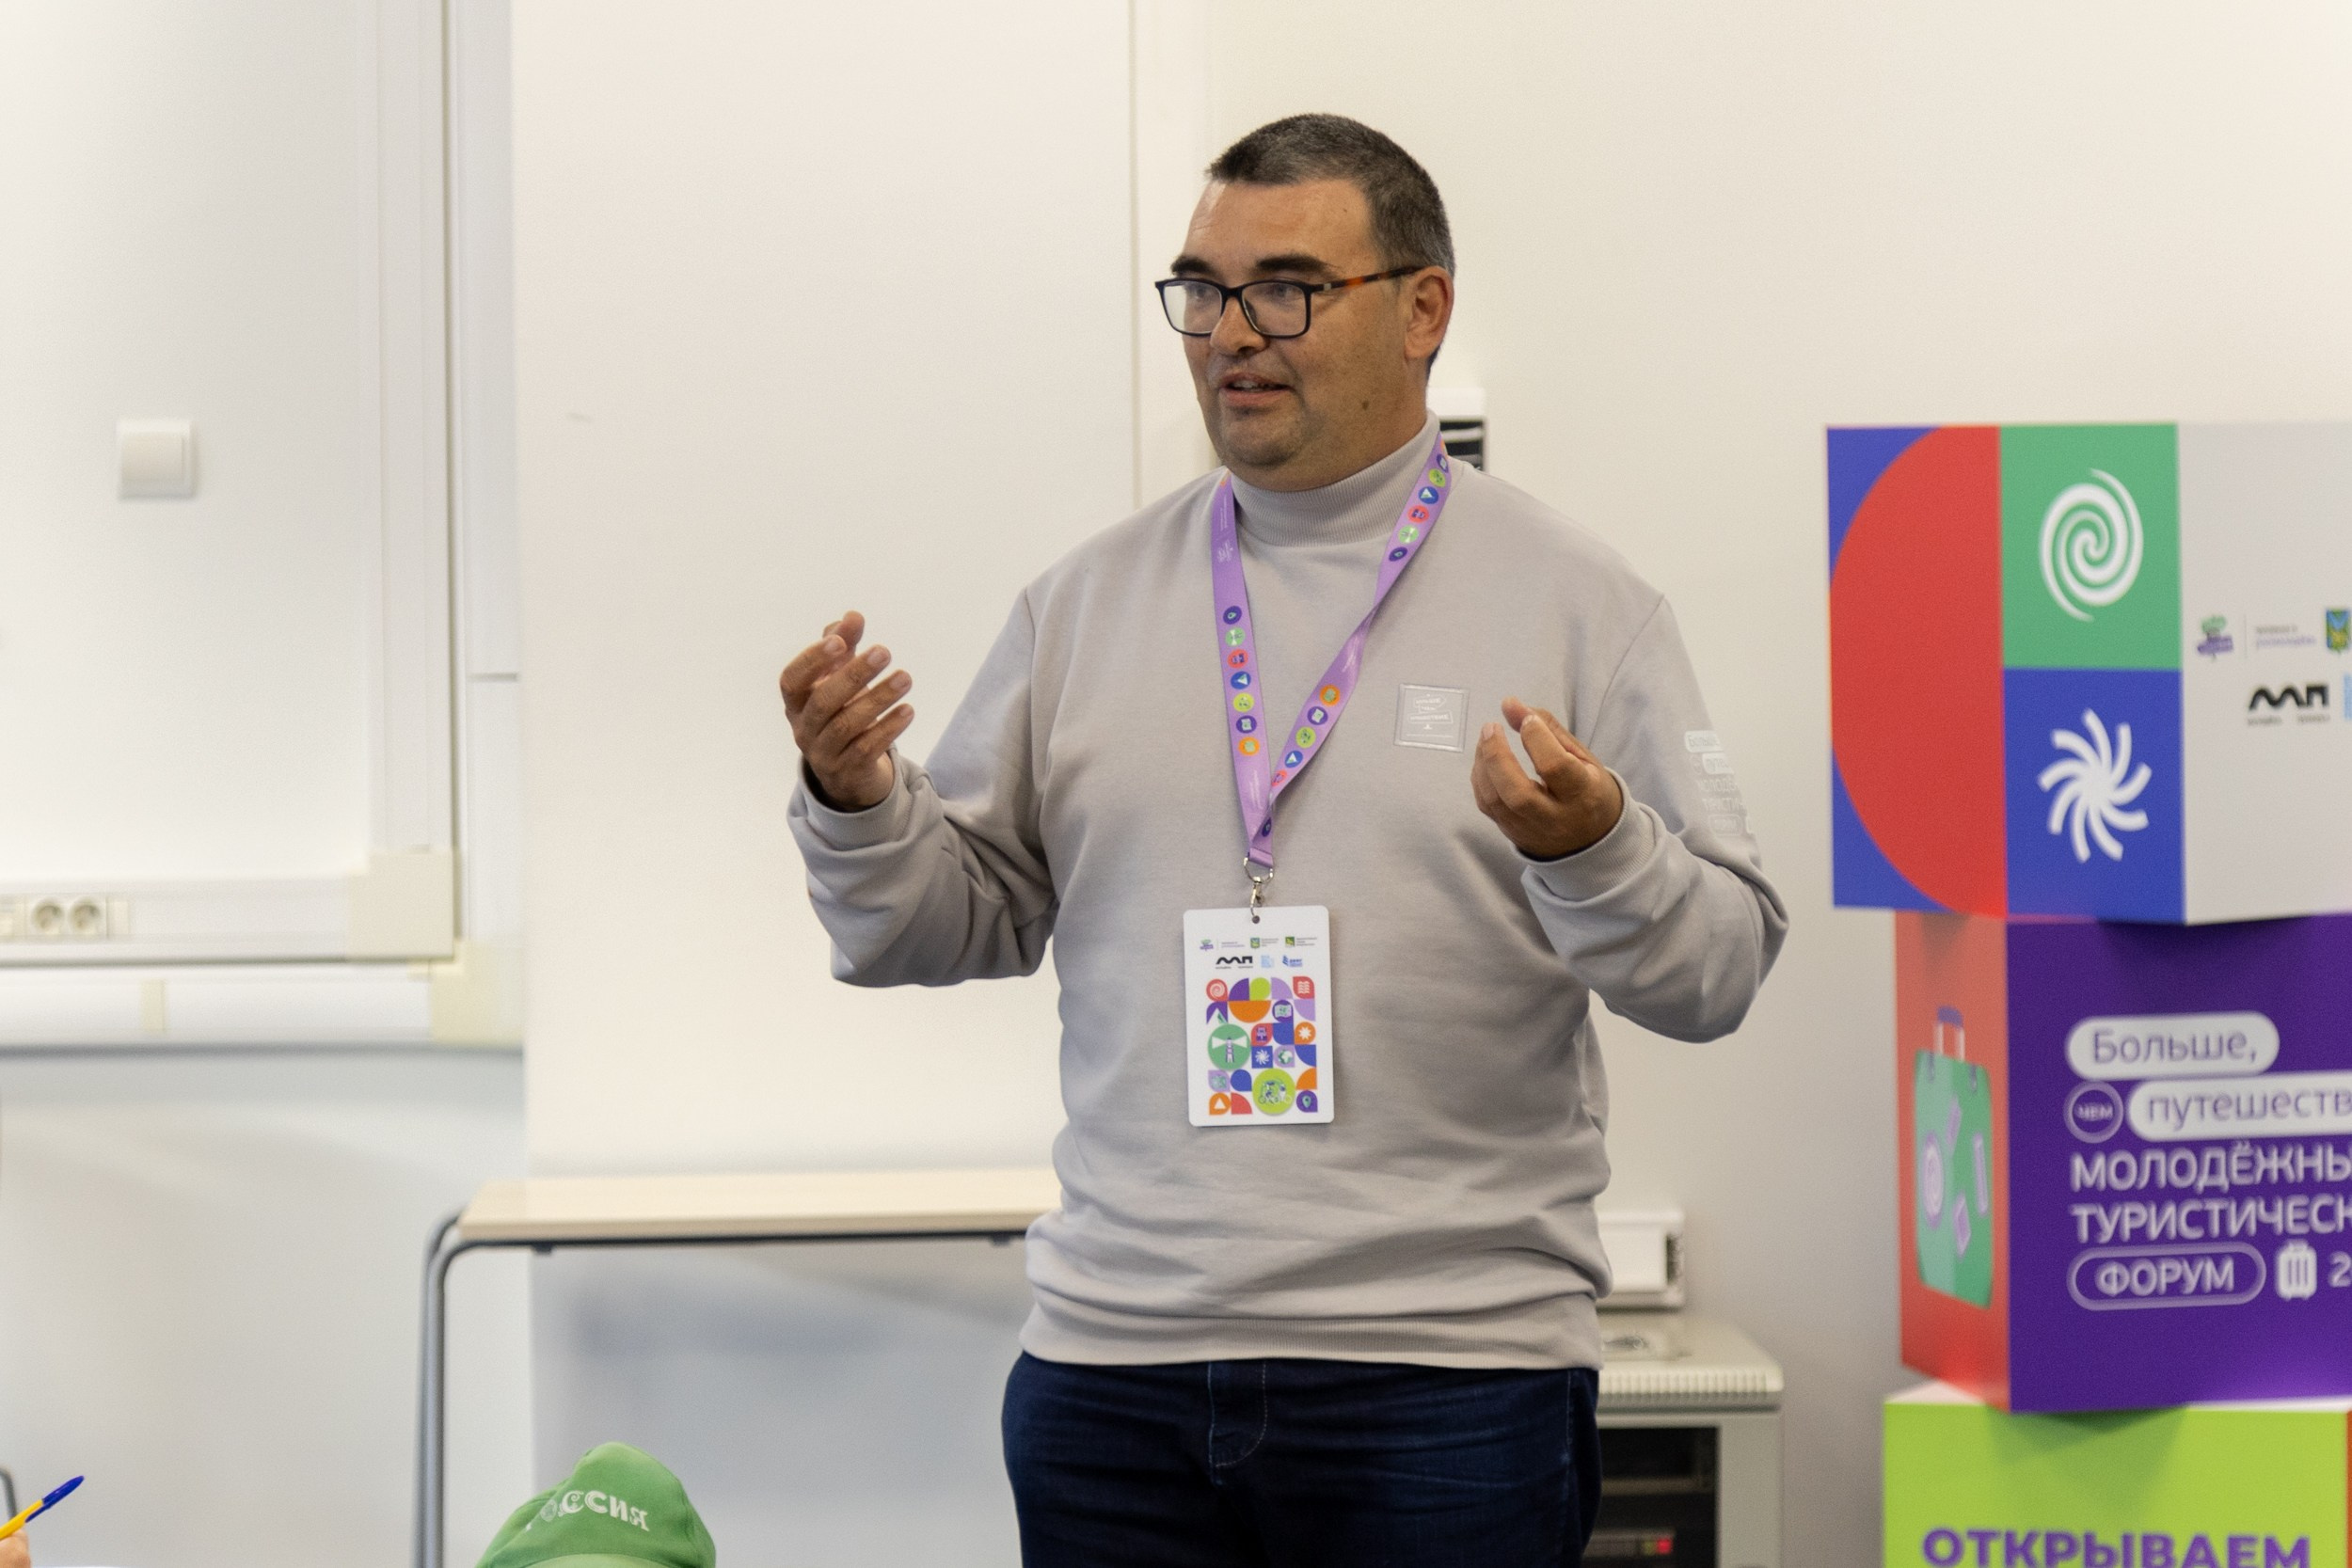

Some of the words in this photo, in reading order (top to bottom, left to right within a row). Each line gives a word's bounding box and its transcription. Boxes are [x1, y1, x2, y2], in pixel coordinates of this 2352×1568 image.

[2092, 1030, 2257, 1065] Больше,
[2149, 1087, 2352, 1132] путешеств
[2094, 1255, 2234, 1296] ФОРУМ
[1922, 1528, 2311, 1568] ОТКРЫВАЕМ
